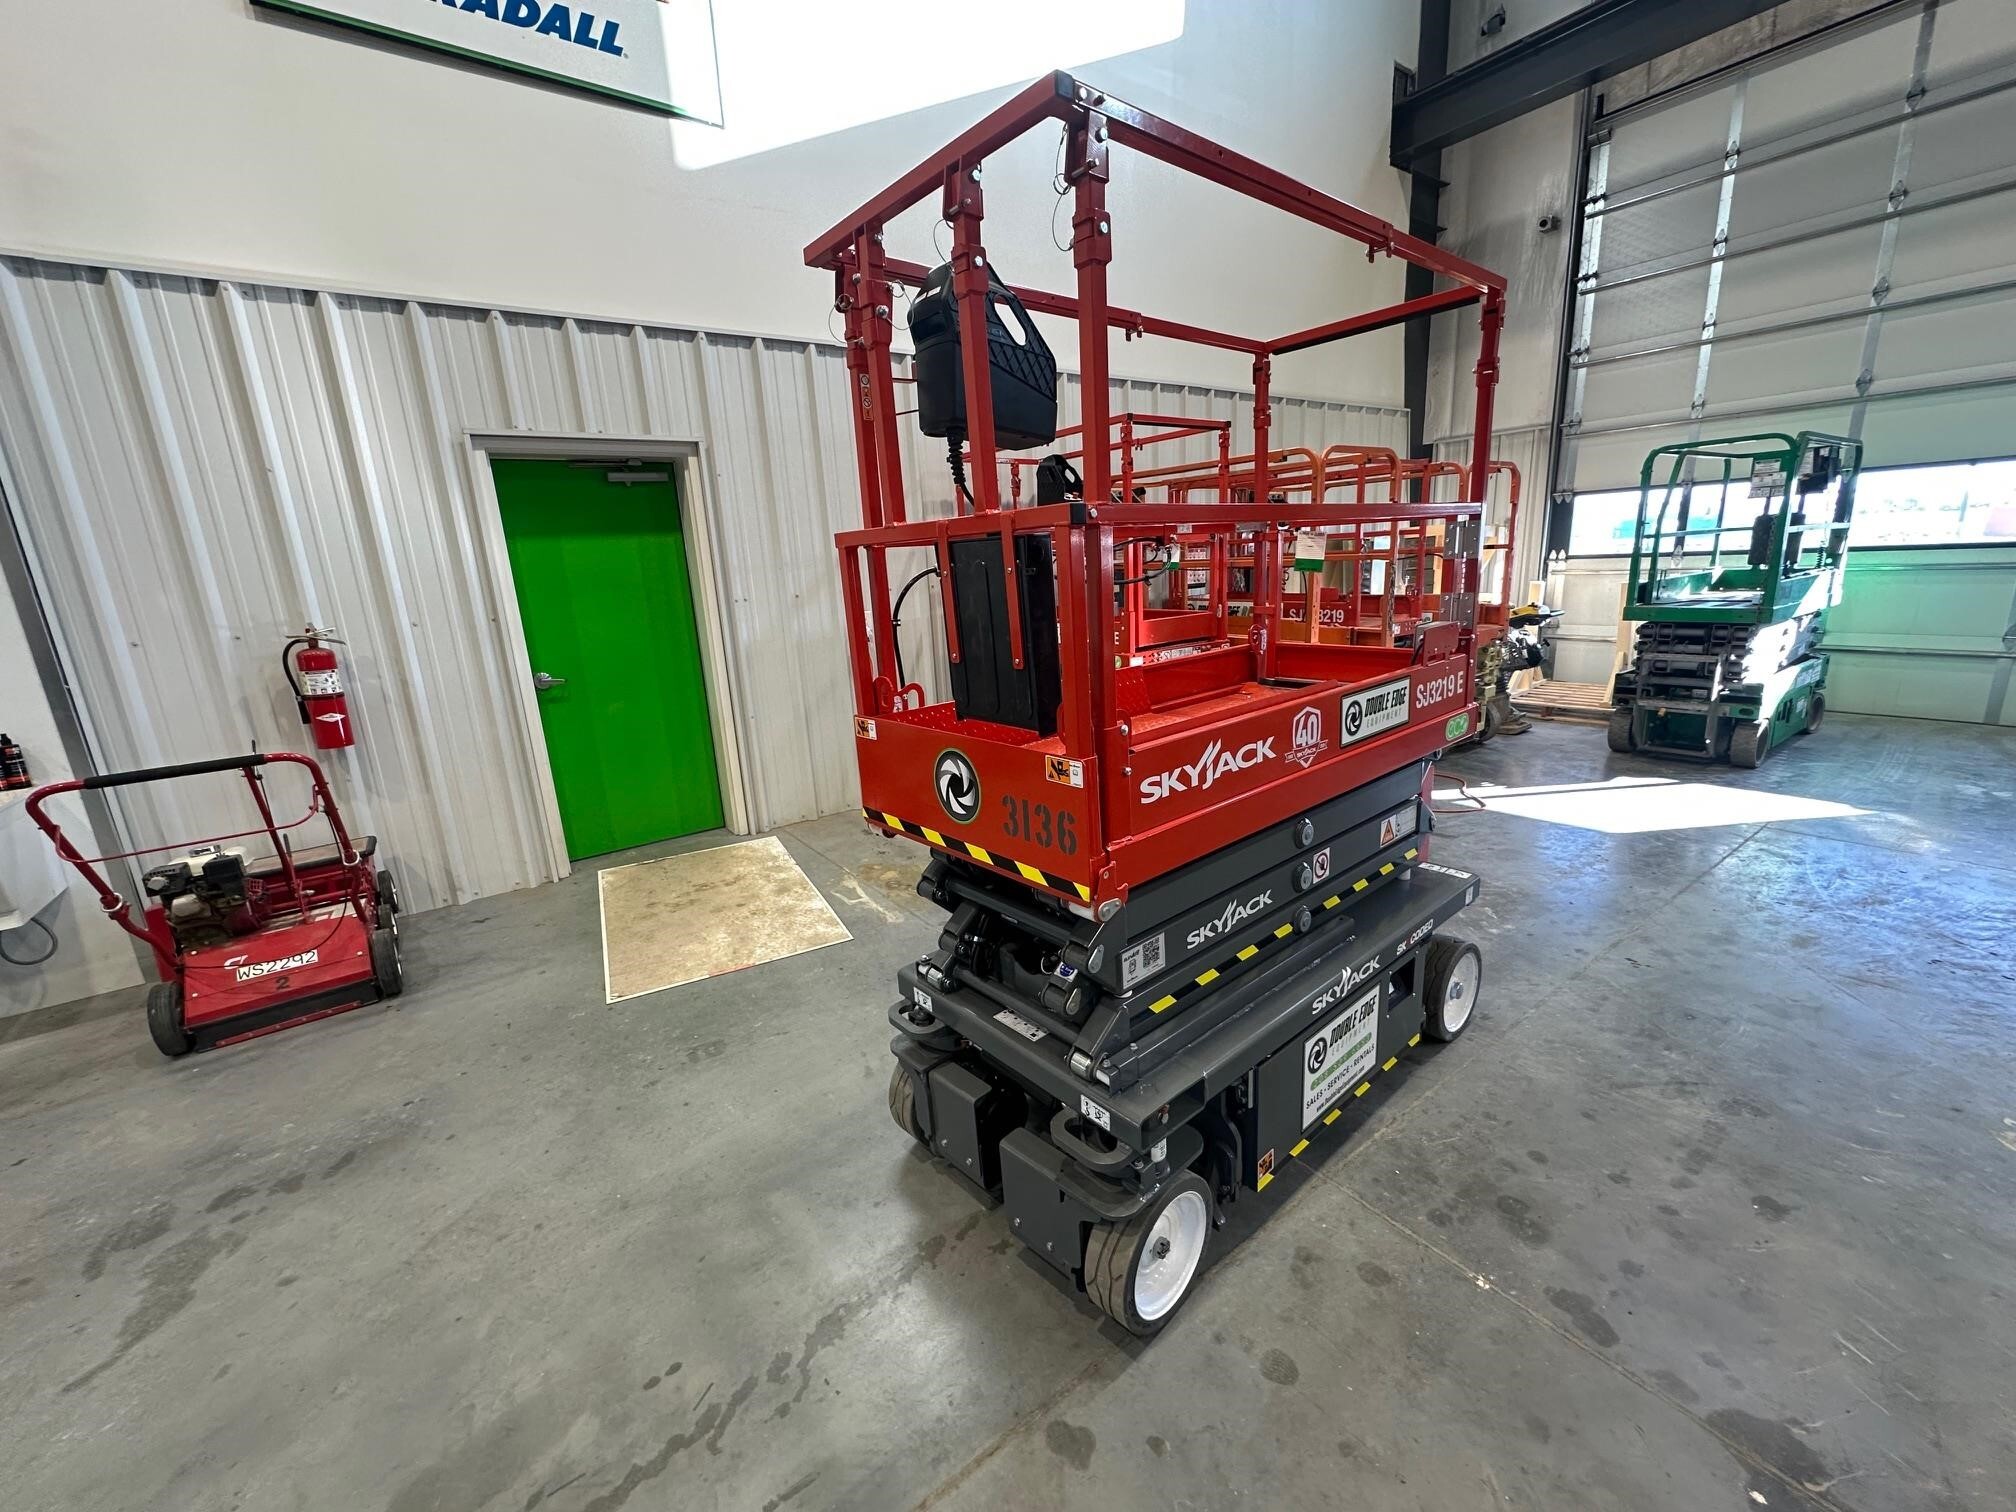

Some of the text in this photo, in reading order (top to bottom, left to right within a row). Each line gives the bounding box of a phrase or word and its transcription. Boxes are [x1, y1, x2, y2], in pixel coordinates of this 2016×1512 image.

[430, 0, 623, 57] ADALL
[1364, 686, 1408, 718] DOUBLE EDGE
[1416, 671, 1464, 709] SJ3219 E
[1296, 714, 1318, 747] 40
[1366, 709, 1401, 729] EQUIPMENT
[1140, 736, 1277, 804] SKYJACK
[1002, 795, 1077, 856] 3136
[1187, 889, 1273, 950] SKYJACK
[238, 951, 316, 980] WS2292
[1311, 955, 1380, 1015] SKYJACK
[1329, 994, 1377, 1048] DOUBLE EDGE
[1306, 1043, 1375, 1110] SALES SERVICE RENTALS
